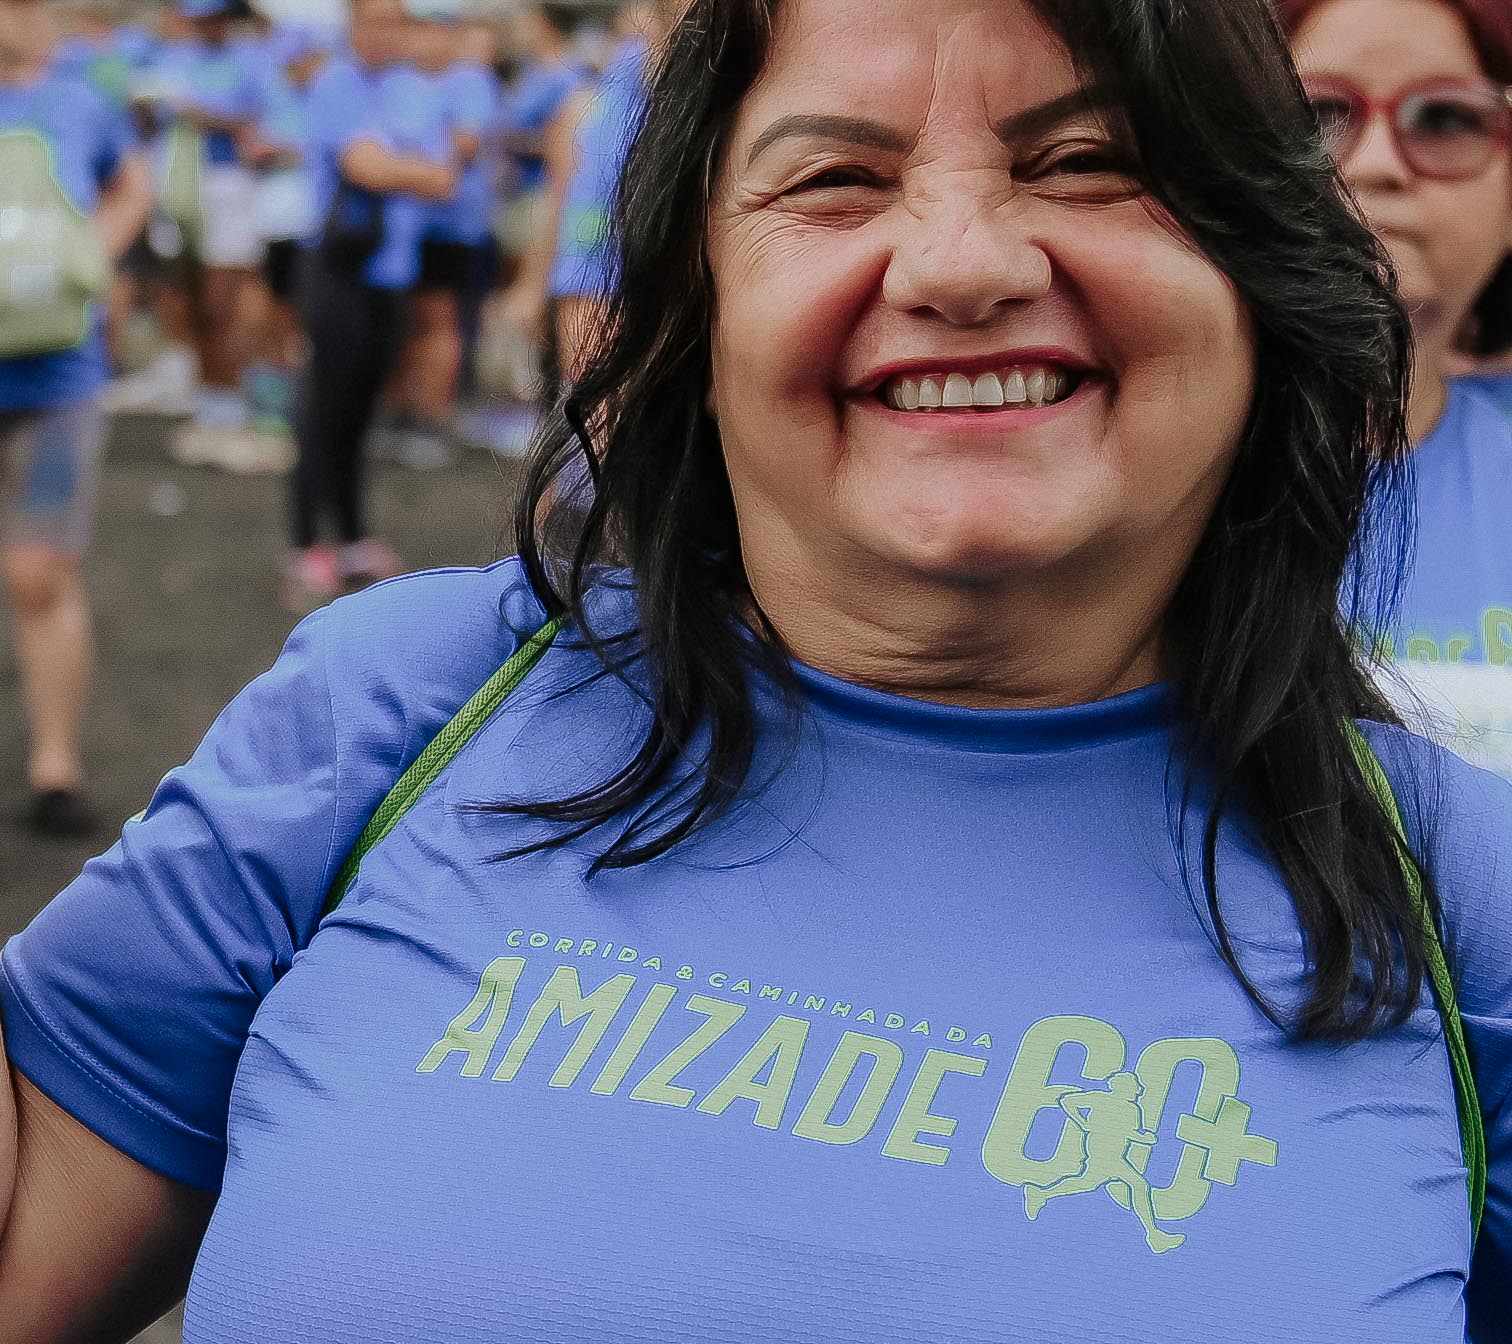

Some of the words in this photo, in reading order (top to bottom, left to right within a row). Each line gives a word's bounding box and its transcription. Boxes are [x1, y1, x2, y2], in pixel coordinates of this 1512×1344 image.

[505, 928, 662, 972] CORRIDA
[675, 964, 694, 981] &
[707, 971, 932, 1037] CAMINHADA
[945, 1025, 994, 1050] DA
[416, 955, 988, 1166] AMIZADE
[981, 1013, 1279, 1236] 60+
